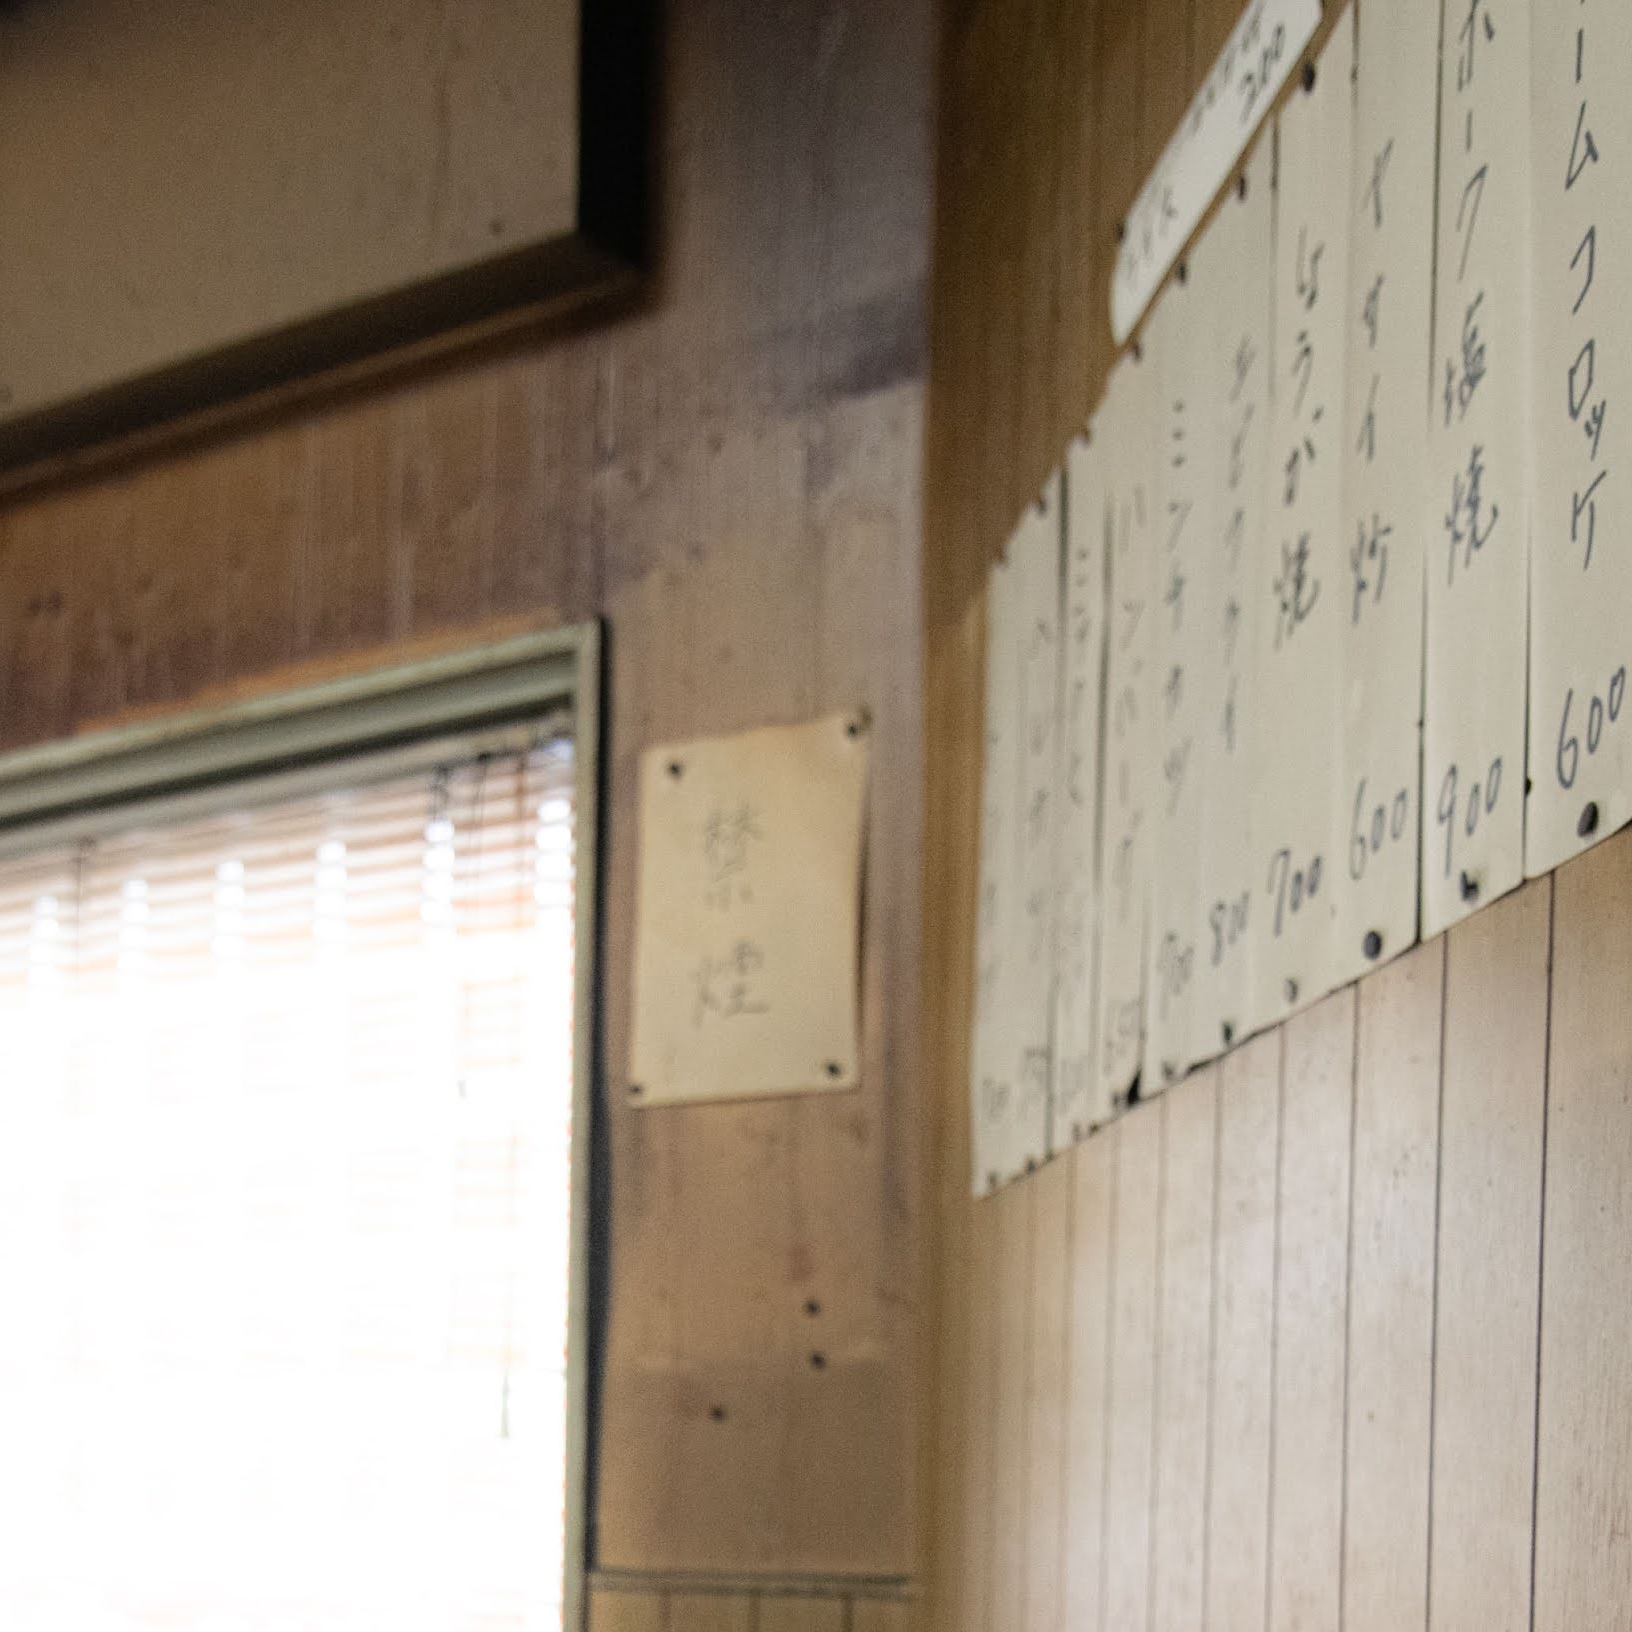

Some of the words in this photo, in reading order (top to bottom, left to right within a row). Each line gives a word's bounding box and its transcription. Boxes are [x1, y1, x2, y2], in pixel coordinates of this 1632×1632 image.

[1557, 667, 1627, 789] 600
[1350, 778, 1407, 880] 600
[1438, 758, 1504, 874] 900
[1268, 848, 1323, 938] 700
